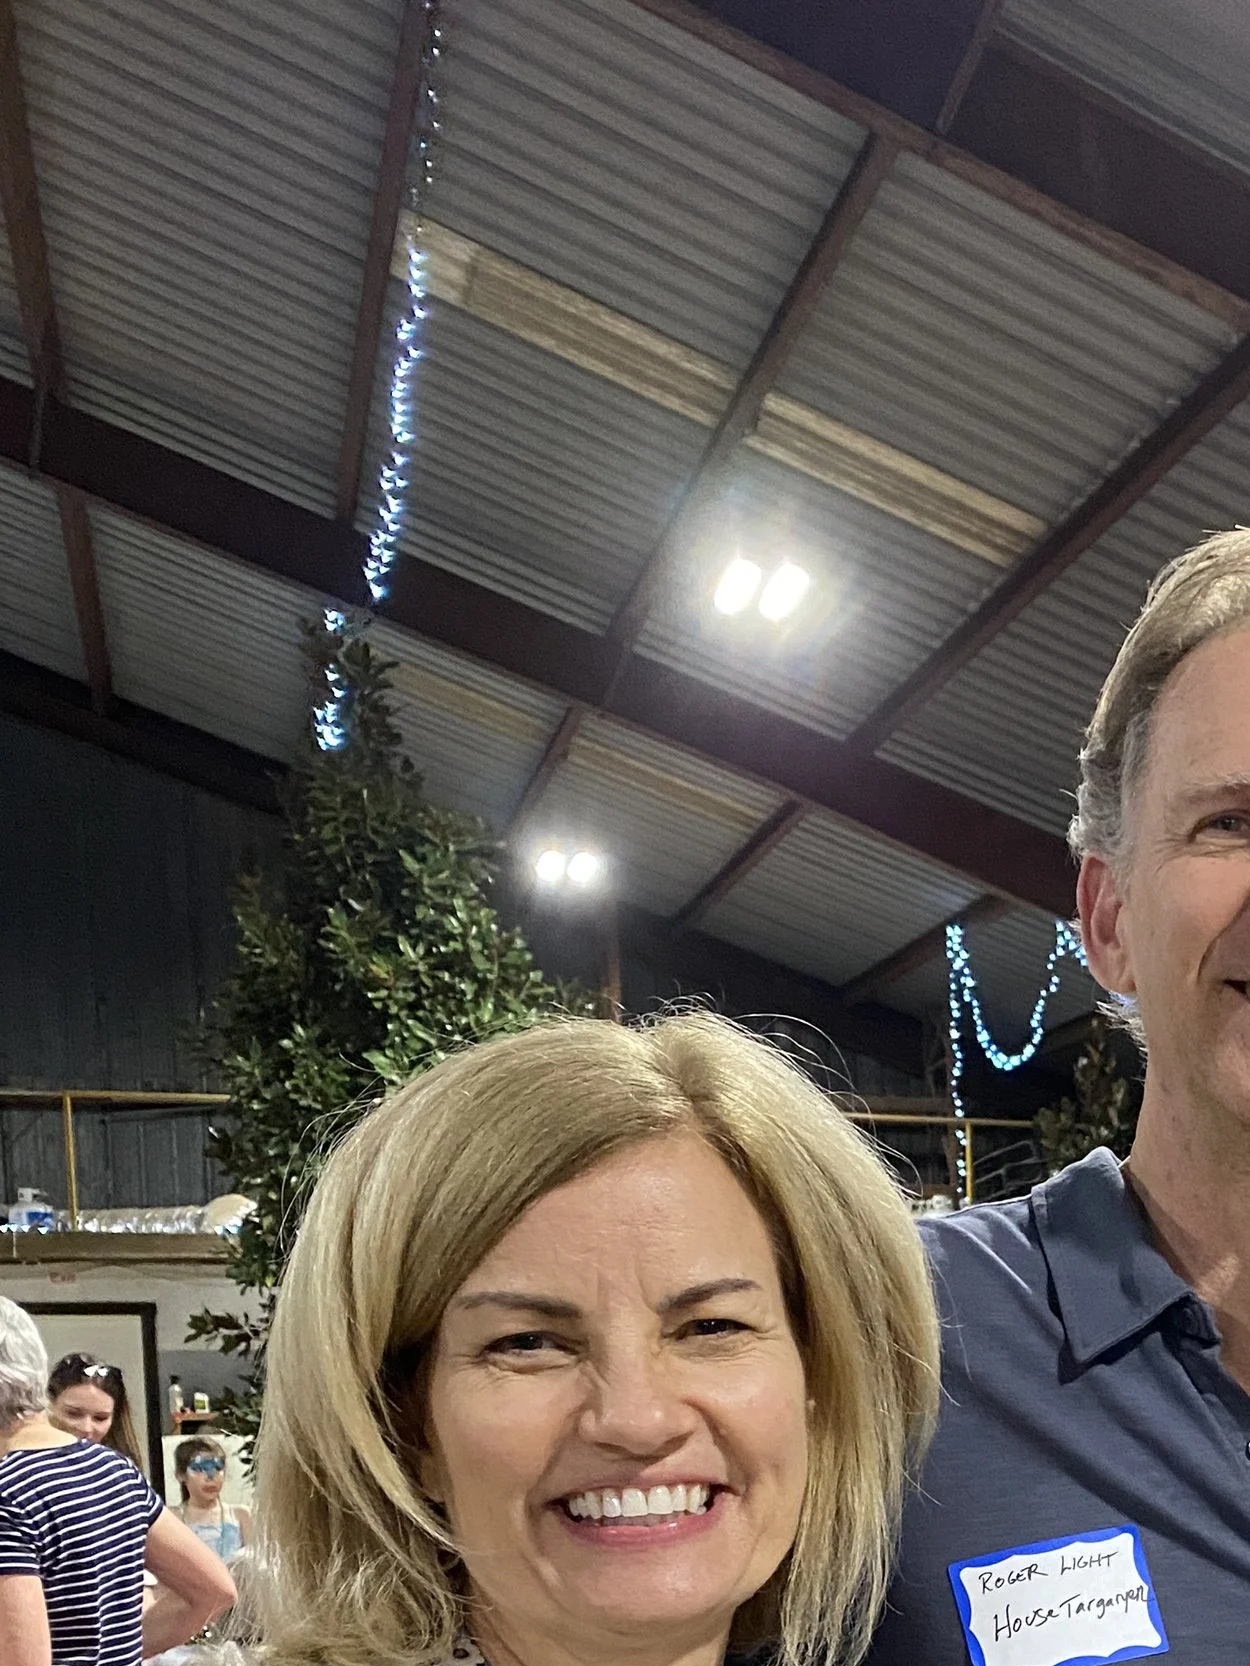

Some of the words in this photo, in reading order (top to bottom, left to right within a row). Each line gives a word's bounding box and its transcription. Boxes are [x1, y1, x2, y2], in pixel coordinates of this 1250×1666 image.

[978, 1563, 1048, 1594] ROGER
[1059, 1551, 1119, 1576] LIGHT
[993, 1603, 1059, 1642] House
[1059, 1584, 1154, 1620] Targaryen
